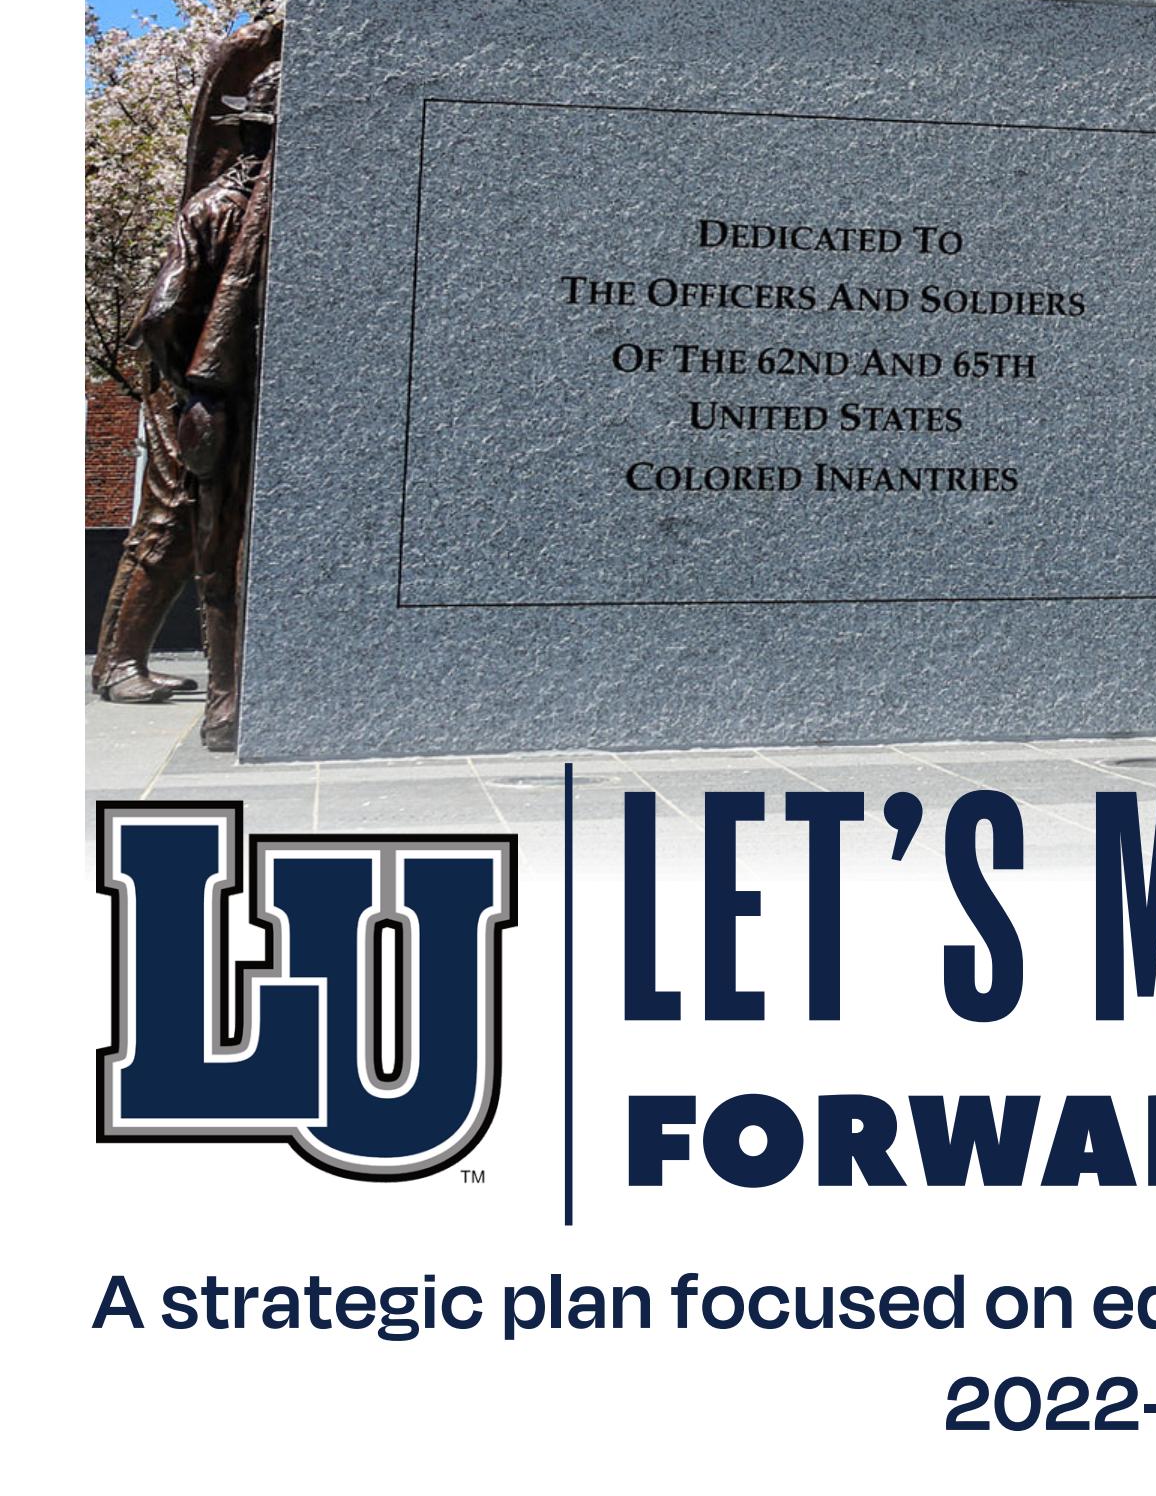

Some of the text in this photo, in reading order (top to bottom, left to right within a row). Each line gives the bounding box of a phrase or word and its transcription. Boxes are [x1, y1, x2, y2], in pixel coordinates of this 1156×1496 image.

[698, 219, 963, 255] DEDICATED TO
[560, 275, 1086, 317] THE OFFICERS AND SOLDIERS
[611, 343, 1036, 380] OF THE 62ND AND 65TH
[689, 401, 963, 433] UNITED STATES
[625, 460, 1018, 493] COLORED INFANTRIES
